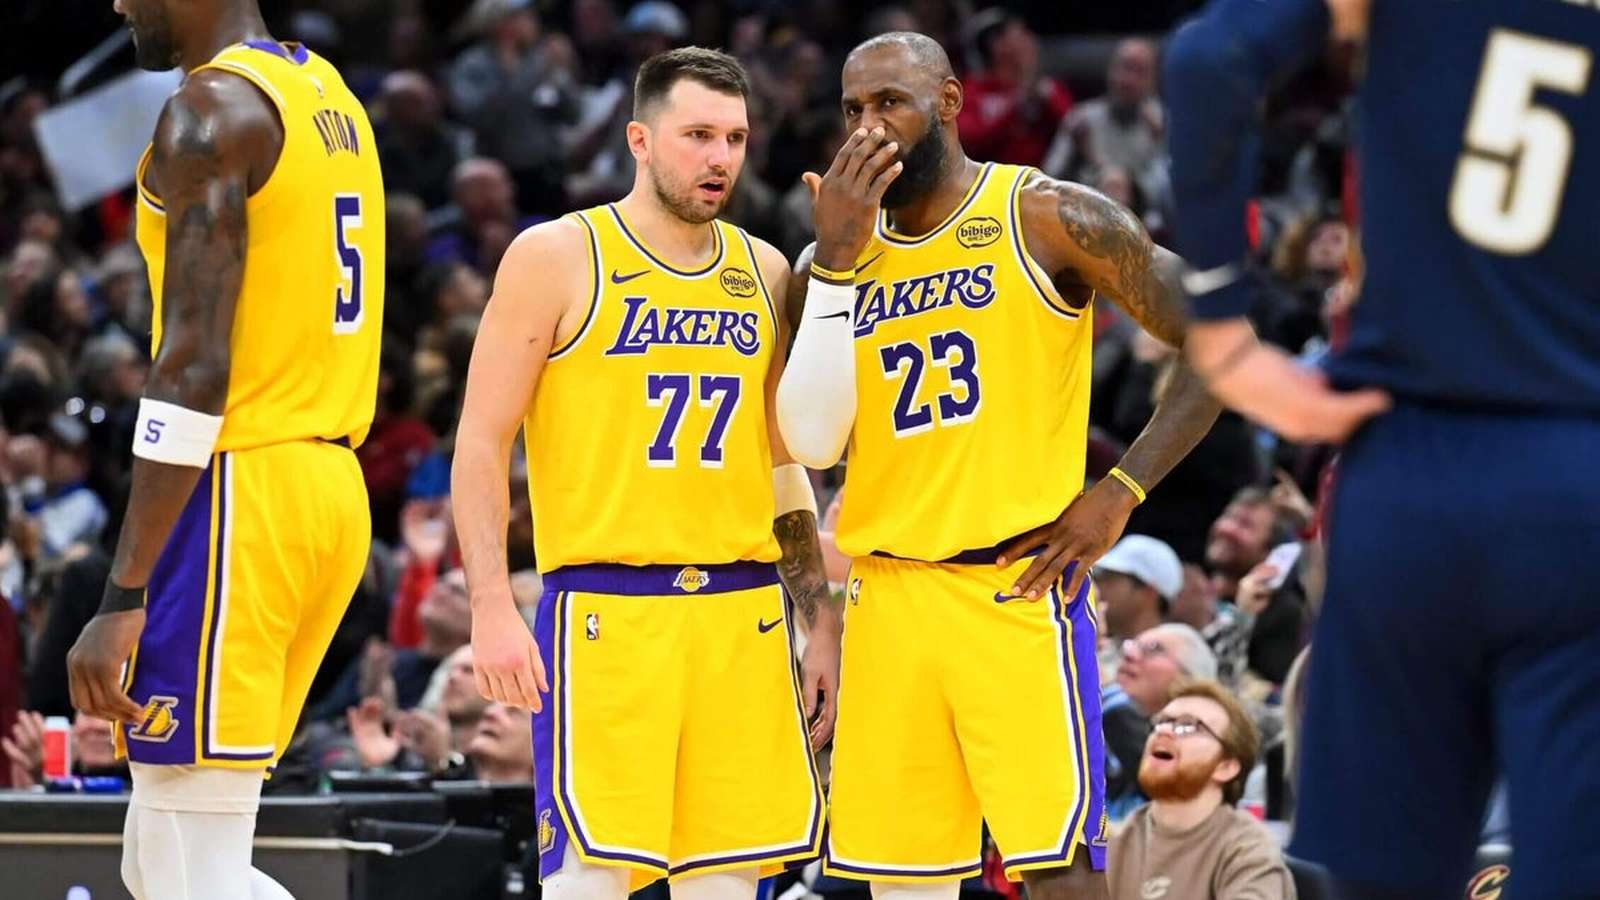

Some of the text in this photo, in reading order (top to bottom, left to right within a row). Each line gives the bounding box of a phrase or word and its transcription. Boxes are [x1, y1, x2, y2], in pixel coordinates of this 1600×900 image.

[312, 109, 360, 157] AYTON
[1447, 28, 1592, 254] 5
[960, 224, 1000, 239] bibigo
[333, 194, 363, 334] 5
[722, 274, 755, 290] bibigo
[603, 296, 762, 357] LAKERS
[879, 329, 981, 436] 23
[144, 418, 167, 444] 5
[646, 373, 742, 467] 77
